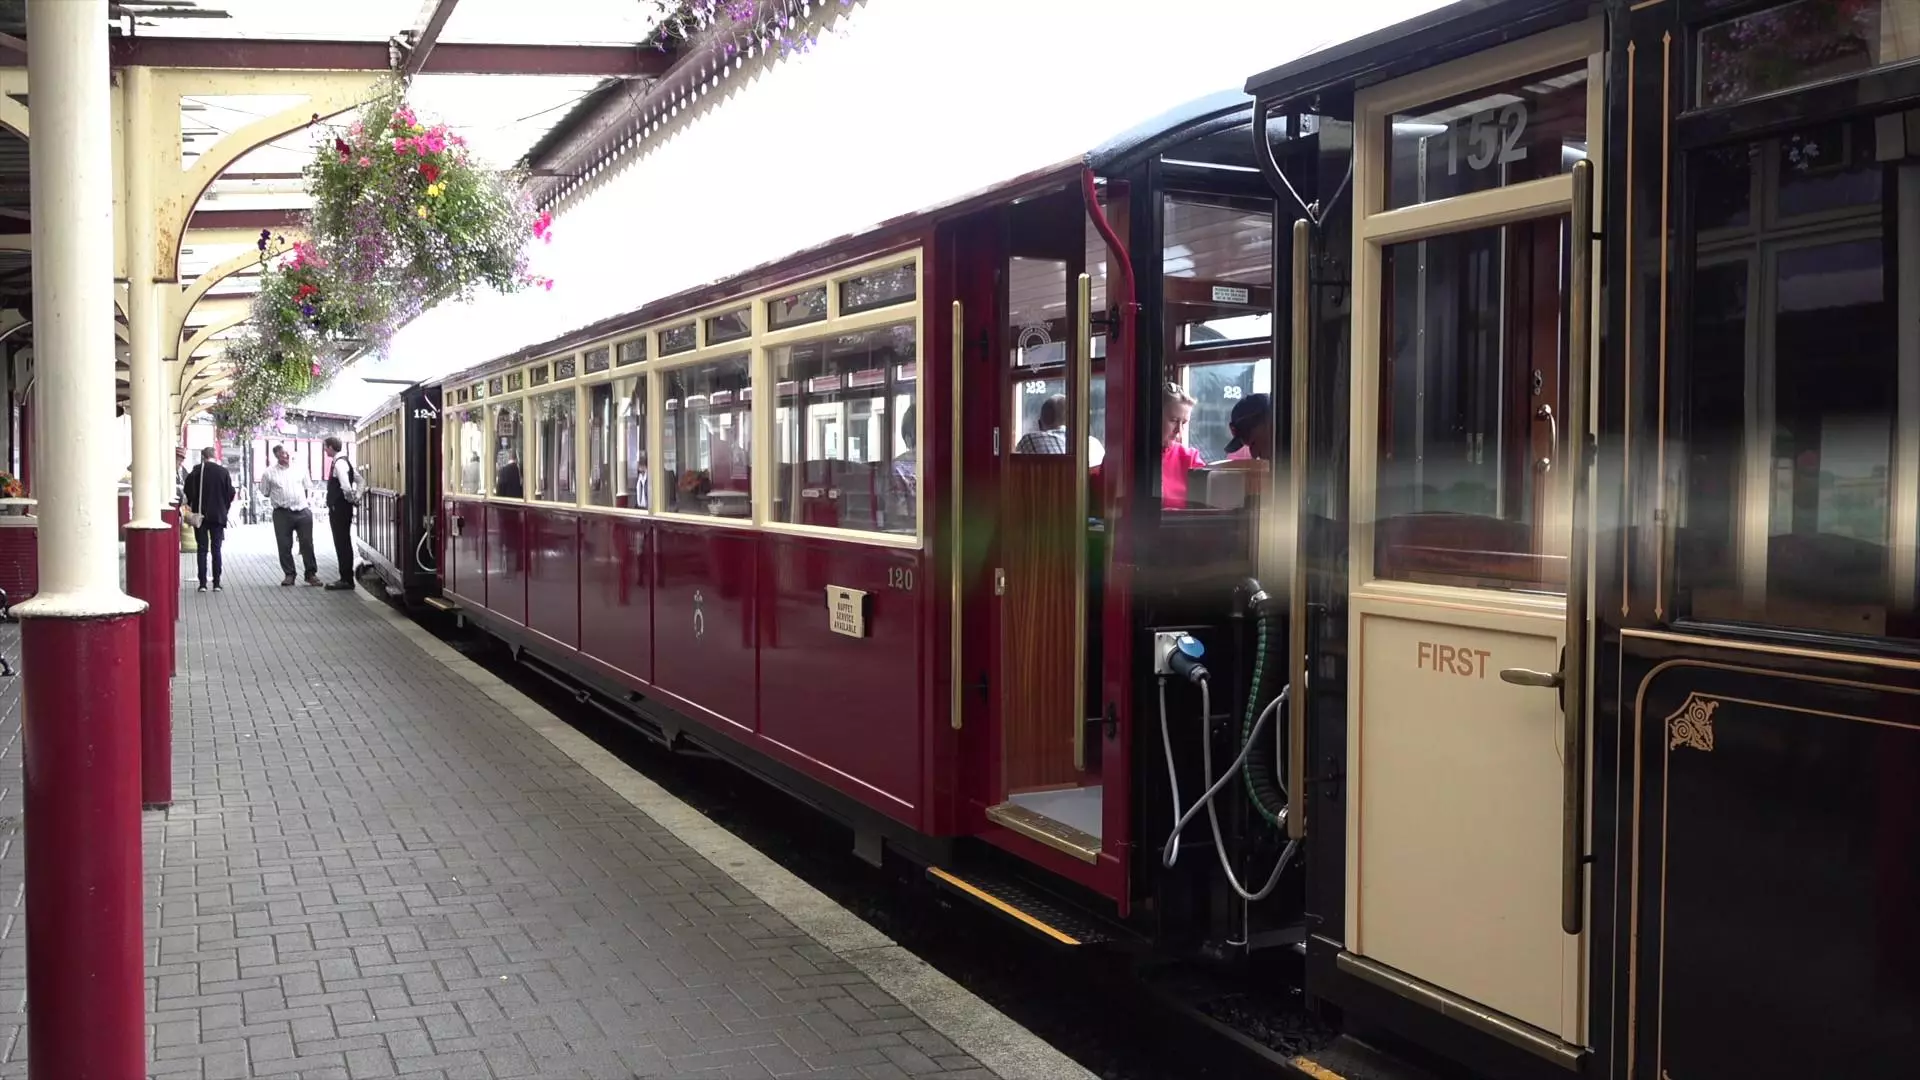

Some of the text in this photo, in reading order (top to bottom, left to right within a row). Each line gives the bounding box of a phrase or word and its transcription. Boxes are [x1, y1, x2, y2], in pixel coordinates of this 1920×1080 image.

[1448, 102, 1527, 176] 152
[887, 567, 913, 590] 120
[833, 620, 857, 634] AVAILABLE
[836, 611, 854, 624] SERVICE
[1417, 641, 1491, 679] FIRST
